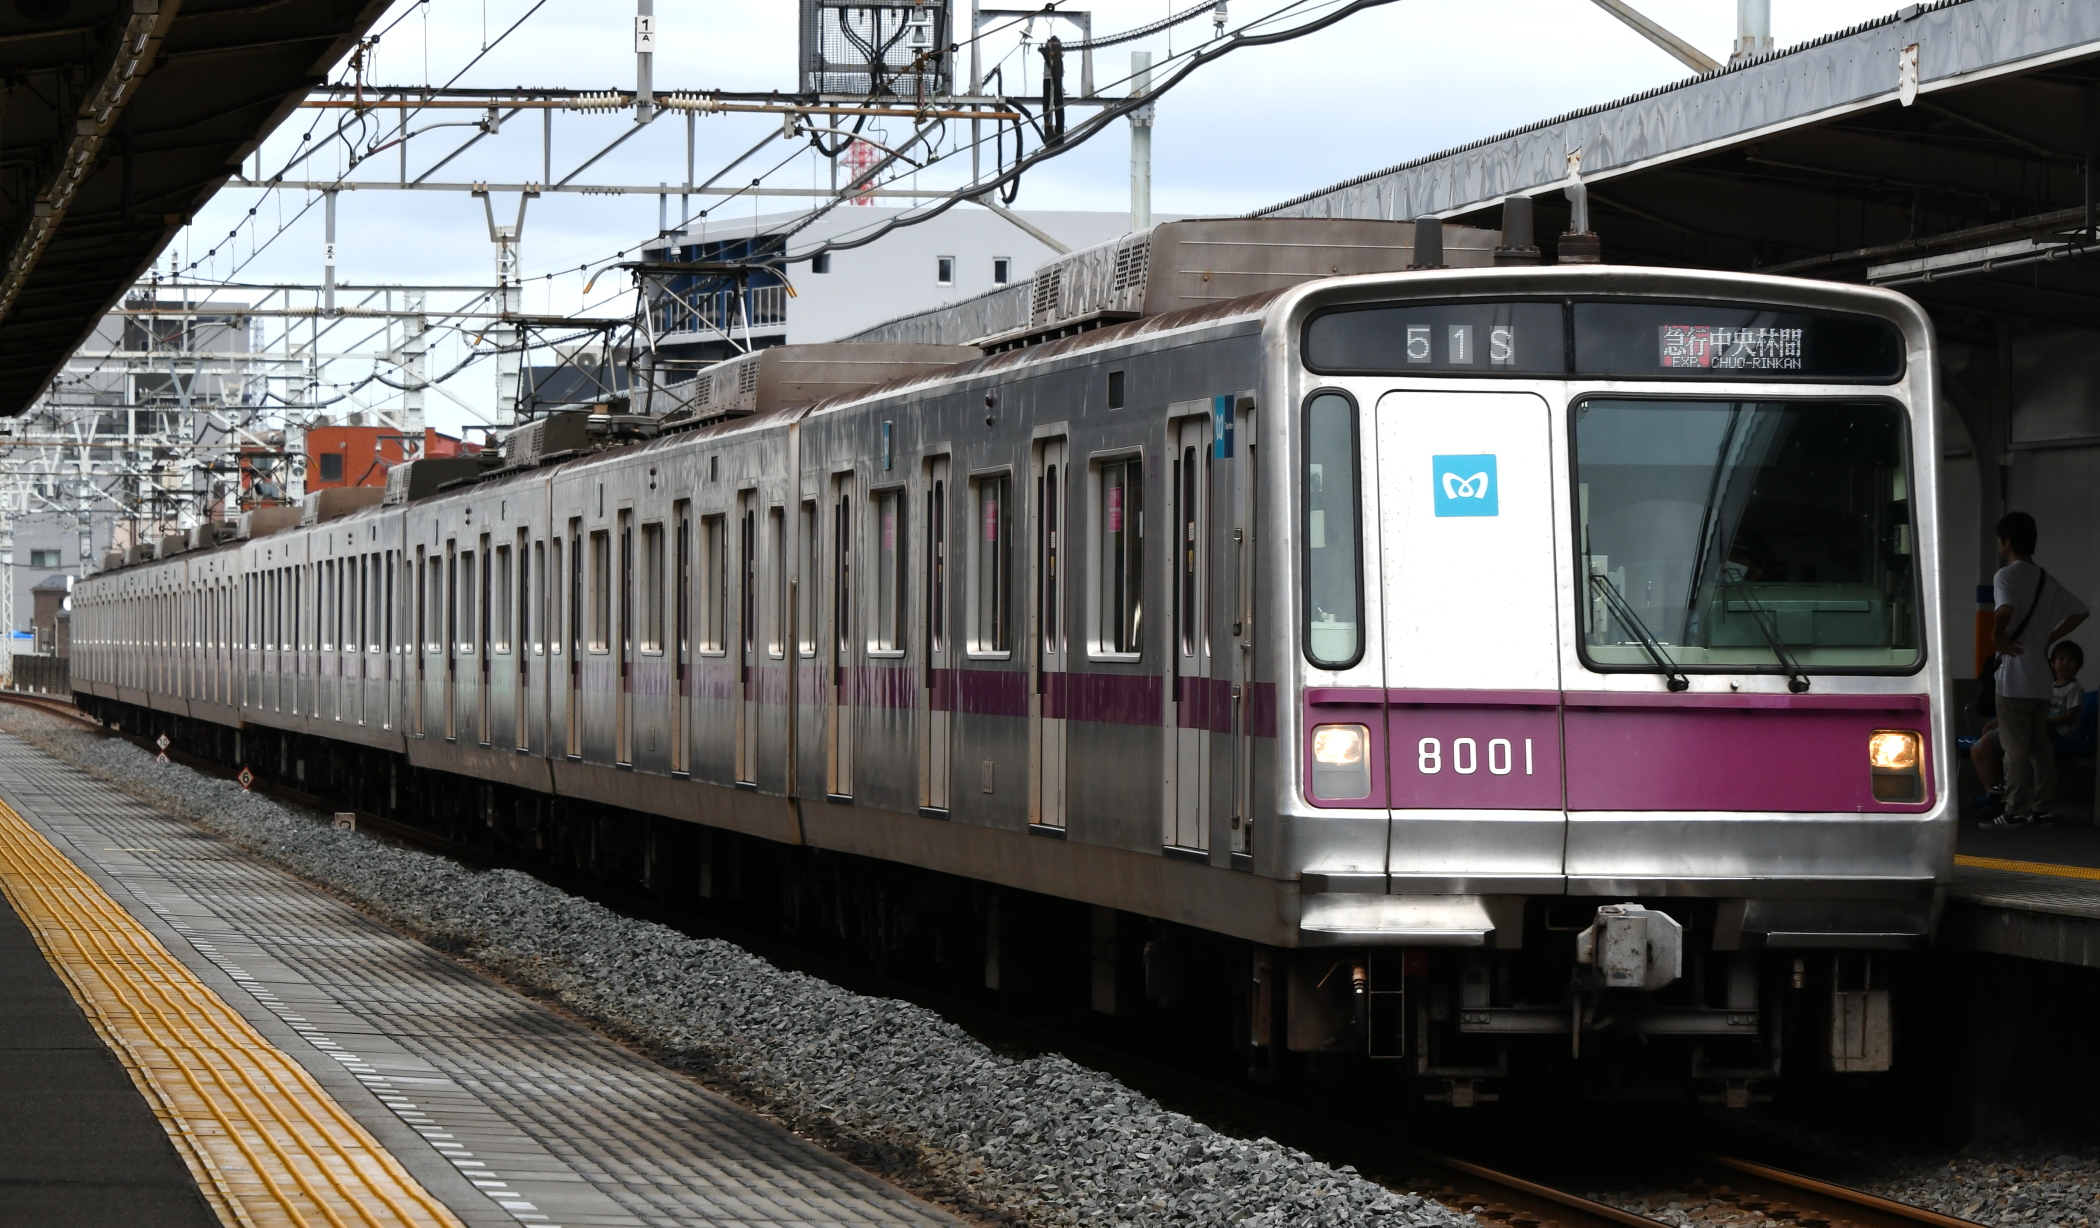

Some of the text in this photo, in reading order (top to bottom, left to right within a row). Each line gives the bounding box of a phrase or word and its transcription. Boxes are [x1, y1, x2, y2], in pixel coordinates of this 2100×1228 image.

[641, 18, 649, 31] 1
[642, 34, 651, 42] A
[327, 245, 334, 254] 2
[1671, 356, 1802, 370] EXP. CHUO-RINKAN
[159, 738, 168, 747] 10
[1418, 737, 1534, 775] 8001
[242, 771, 250, 784] 6
